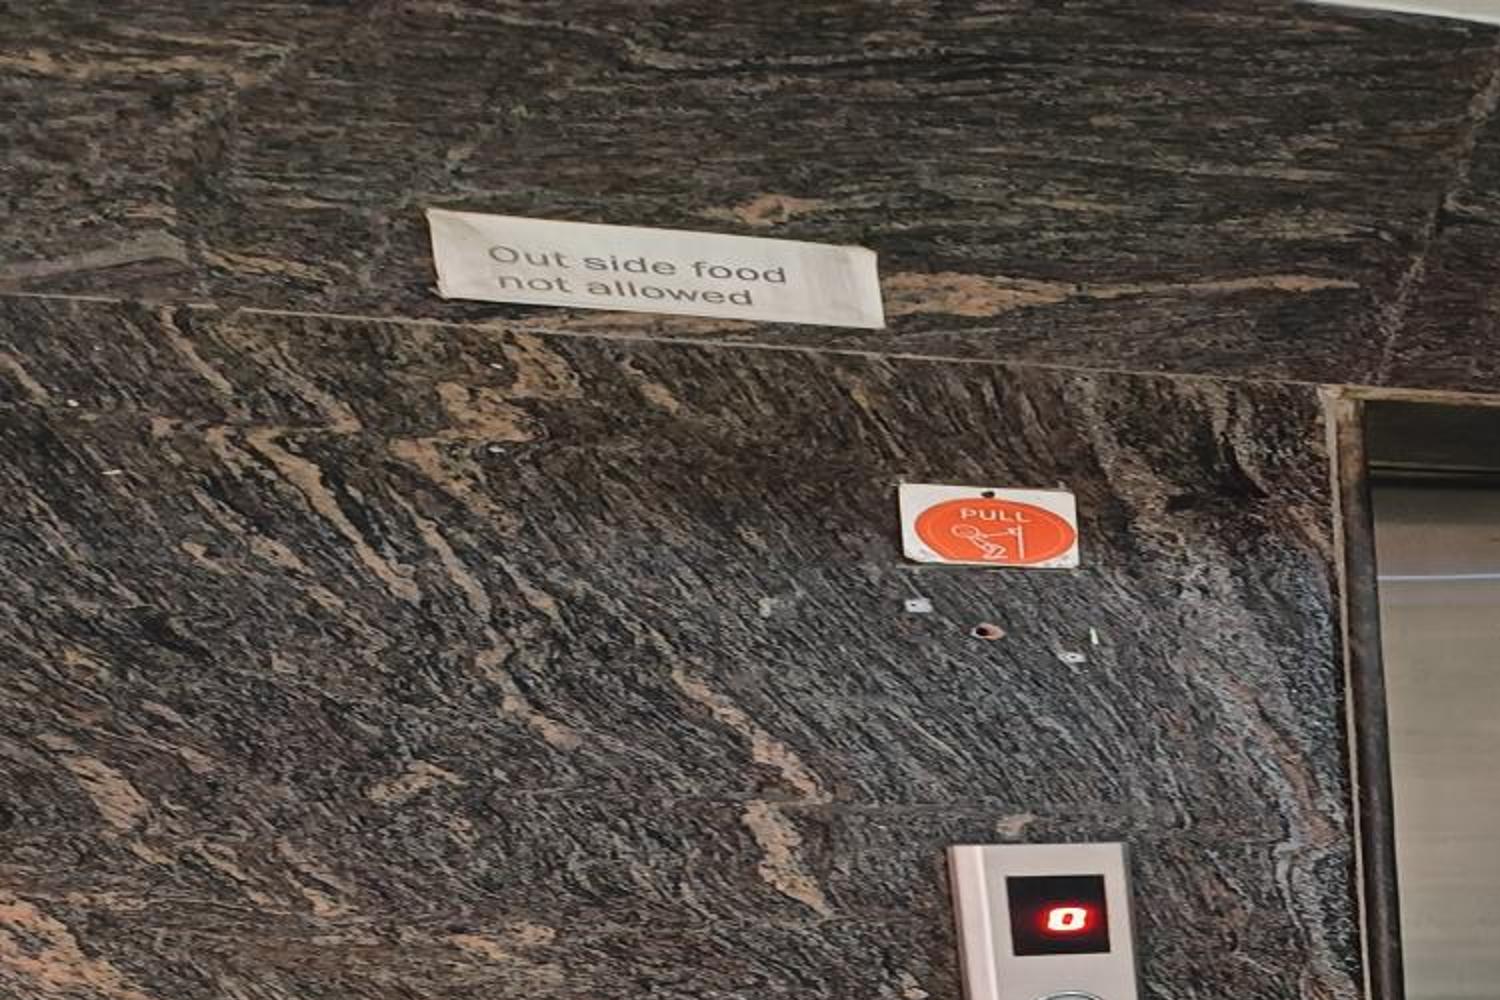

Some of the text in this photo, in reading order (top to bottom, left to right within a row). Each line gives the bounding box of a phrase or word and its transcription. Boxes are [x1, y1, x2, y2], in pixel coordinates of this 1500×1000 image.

[488, 246, 786, 284] Out side food
[498, 274, 753, 306] not allowed
[959, 507, 1032, 522] PULL
